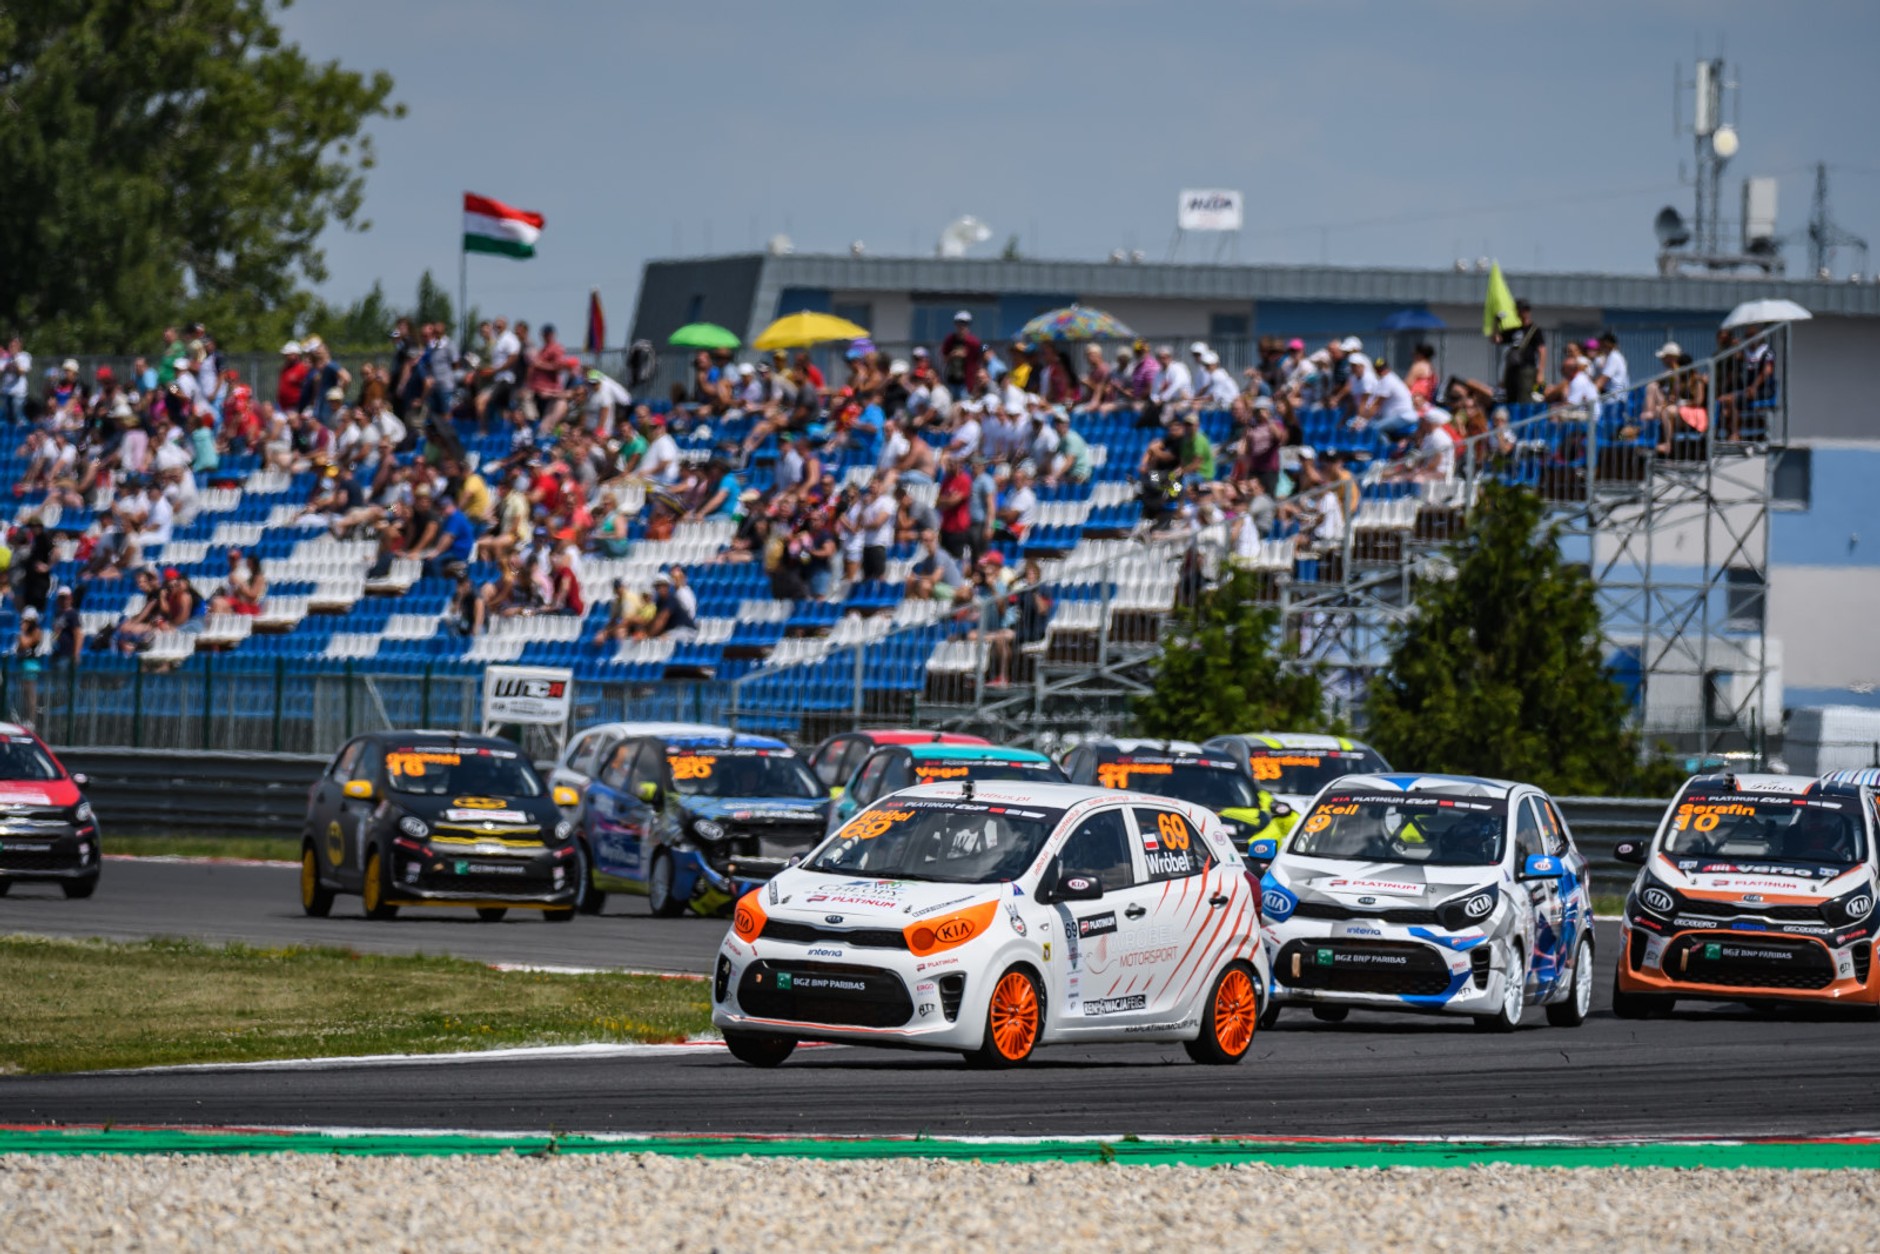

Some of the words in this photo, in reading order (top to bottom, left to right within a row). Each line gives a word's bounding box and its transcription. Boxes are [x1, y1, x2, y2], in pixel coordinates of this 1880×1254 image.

[904, 801, 956, 809] PLATINUM
[1352, 796, 1404, 804] PLATINUM
[1678, 803, 1756, 817] Serafin
[840, 820, 892, 839] 69
[1304, 814, 1332, 833] 9
[1674, 813, 1721, 832] 10
[1157, 812, 1190, 851] 69
[1146, 851, 1191, 876] Wróbel
[1352, 880, 1417, 891] PLATINUM
[1734, 880, 1798, 889] PLATINUM
[831, 895, 897, 909] PLATINUM
[1264, 893, 1284, 911] KIA
[1469, 897, 1491, 915] KIA
[1647, 891, 1667, 909] KIA
[1850, 899, 1871, 915] KIA
[942, 922, 970, 939] KIA
[1065, 922, 1077, 939] 69
[1089, 917, 1116, 930] PLATINUM
[1347, 927, 1381, 936] interia
[1119, 946, 1179, 967] MOTORSPORT
[1353, 955, 1371, 963] BNP
[1371, 955, 1406, 965] PARIBAS
[1741, 949, 1758, 957] BNP
[1758, 951, 1793, 959] PARIBAS
[927, 957, 959, 968] PLATINUM
[810, 978, 829, 988] BNP
[829, 979, 866, 991] PARIBAS
[916, 983, 935, 992] ERGO
